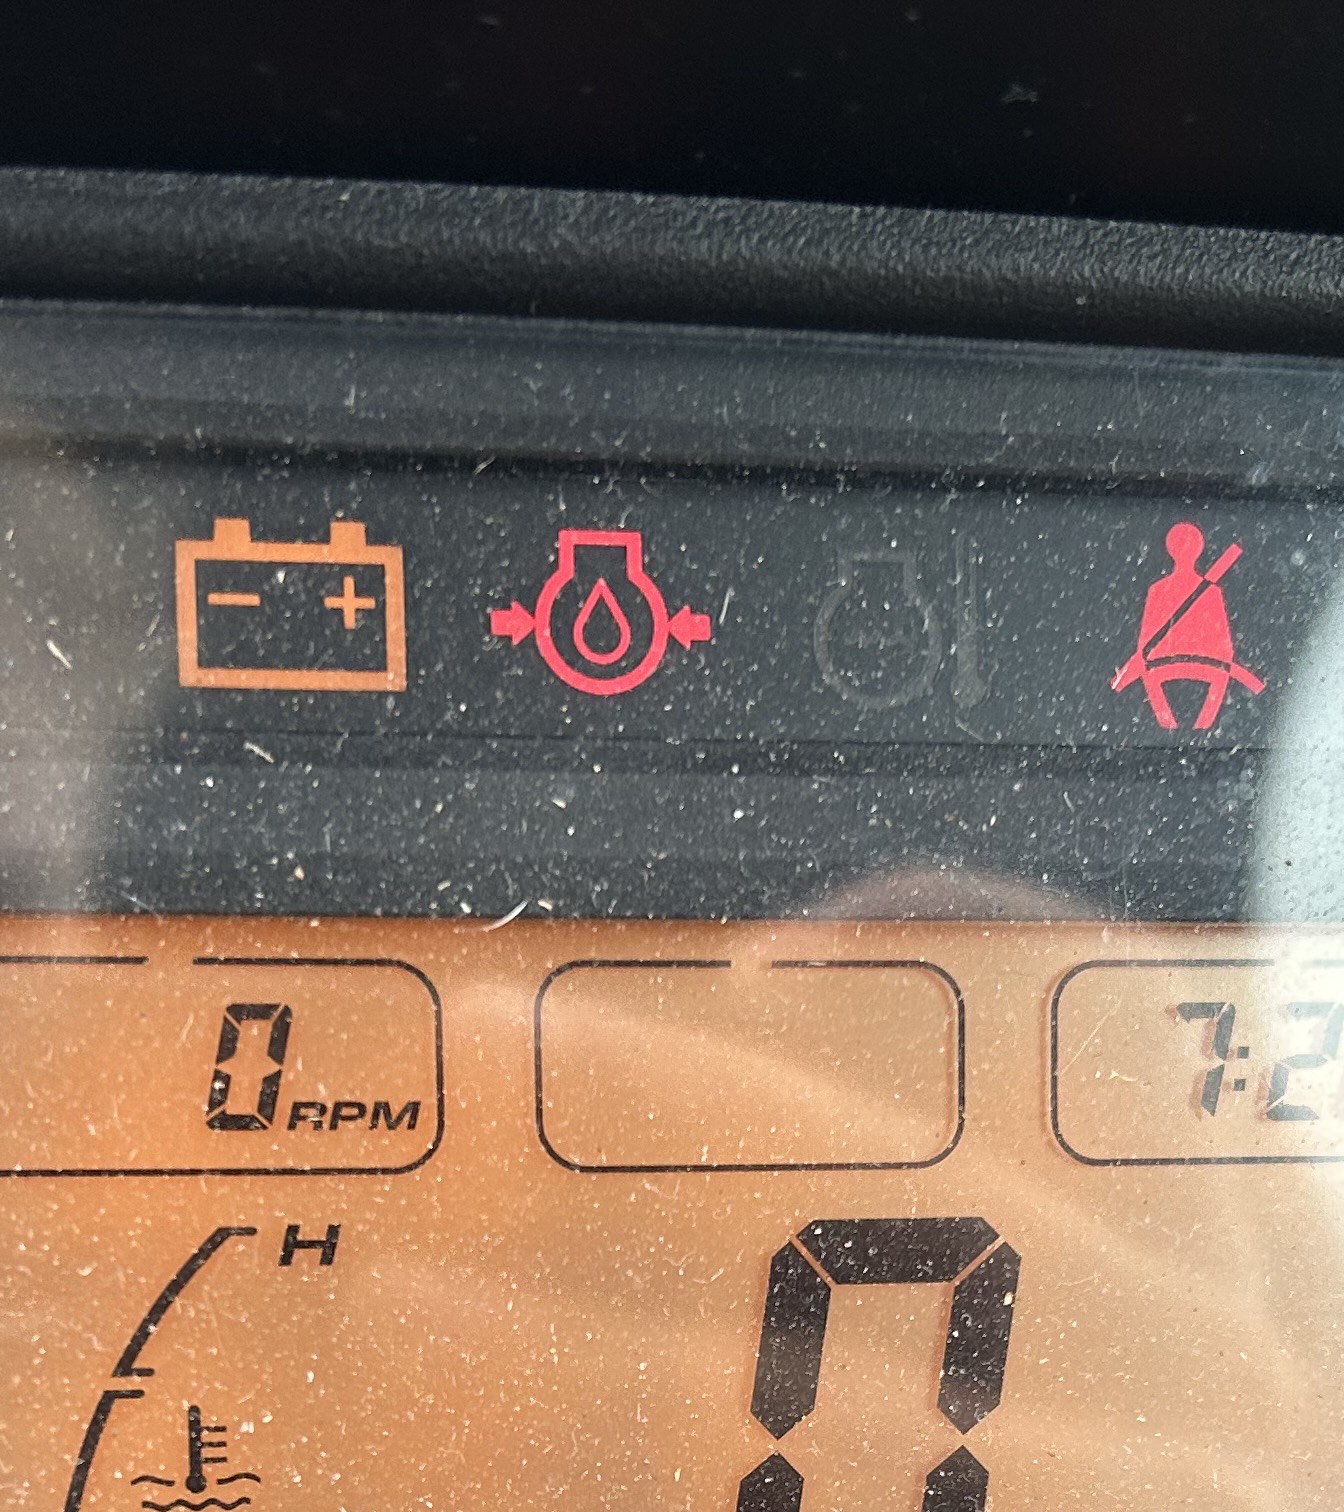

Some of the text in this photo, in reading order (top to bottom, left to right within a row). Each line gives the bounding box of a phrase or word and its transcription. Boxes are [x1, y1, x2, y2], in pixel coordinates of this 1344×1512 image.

[206, 1002, 422, 1132] 0 RPM
[278, 1223, 342, 1267] H
